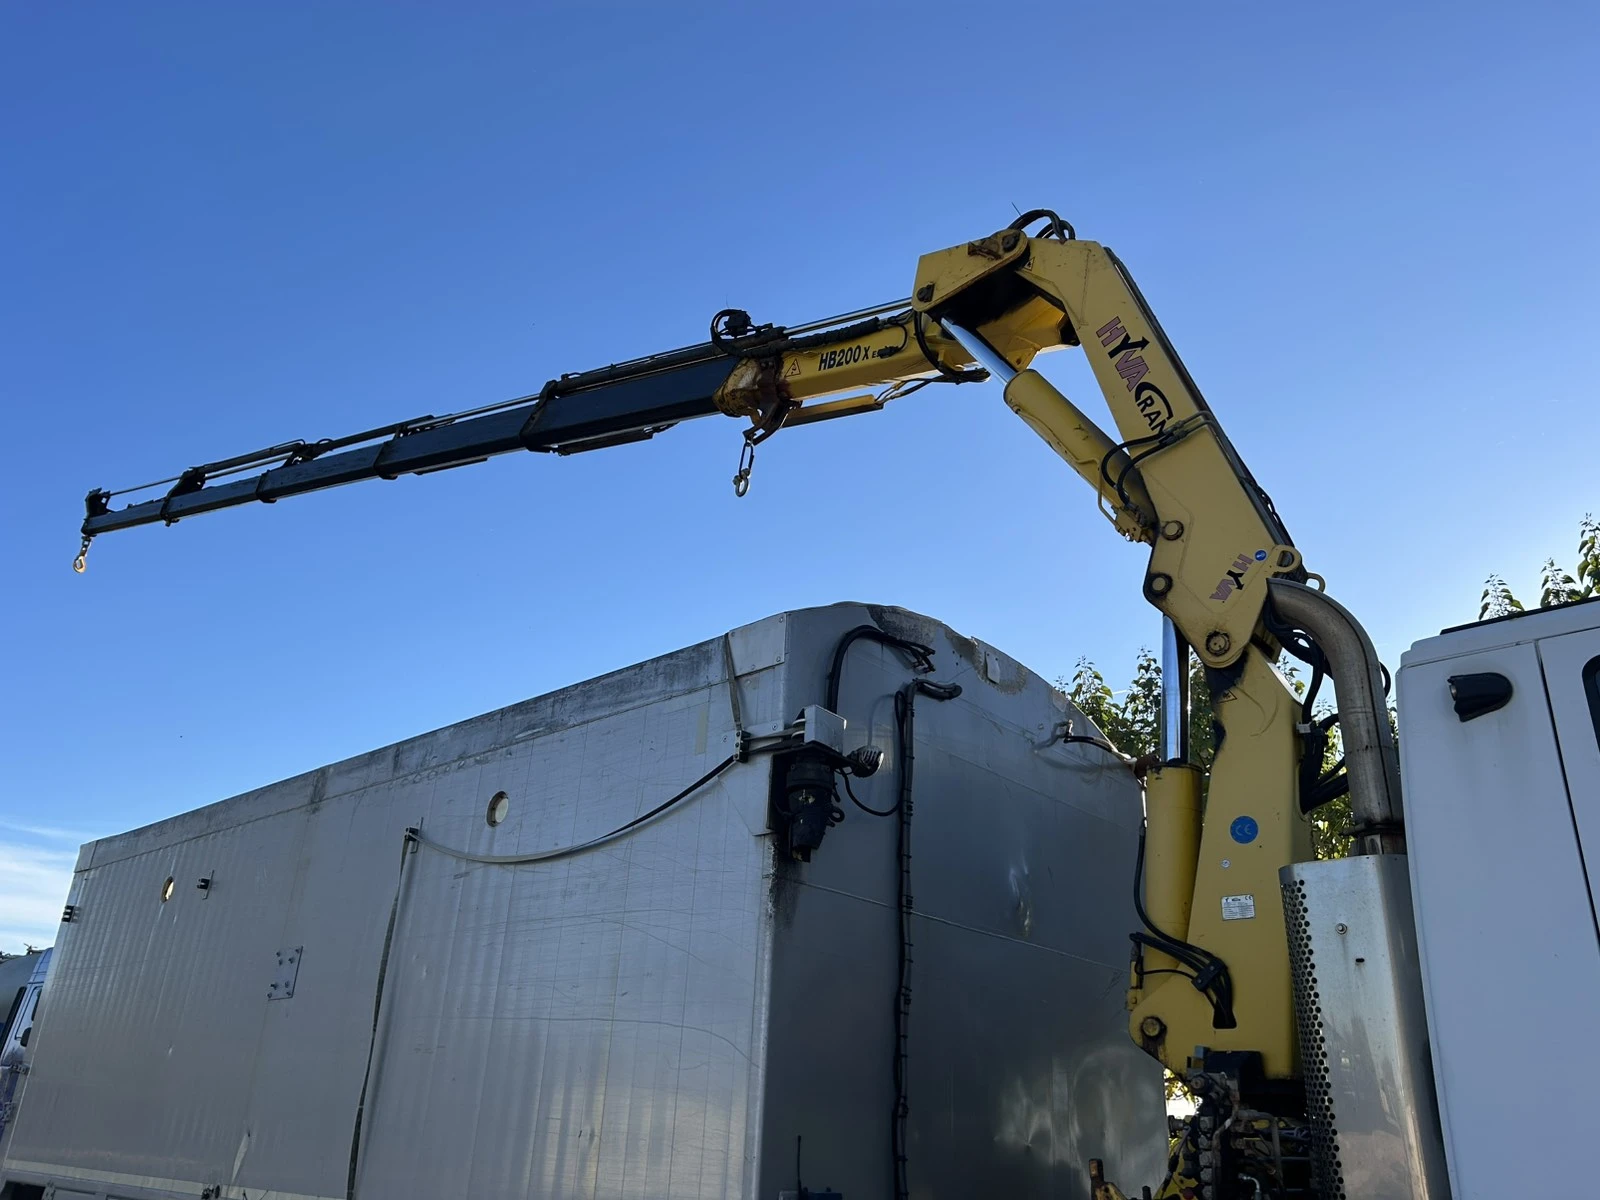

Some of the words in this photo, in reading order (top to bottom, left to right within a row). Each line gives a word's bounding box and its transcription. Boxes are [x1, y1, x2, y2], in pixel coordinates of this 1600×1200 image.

[1096, 316, 1150, 392] HYVA
[1135, 381, 1174, 435] CRAN
[1209, 553, 1254, 601] HYVA
